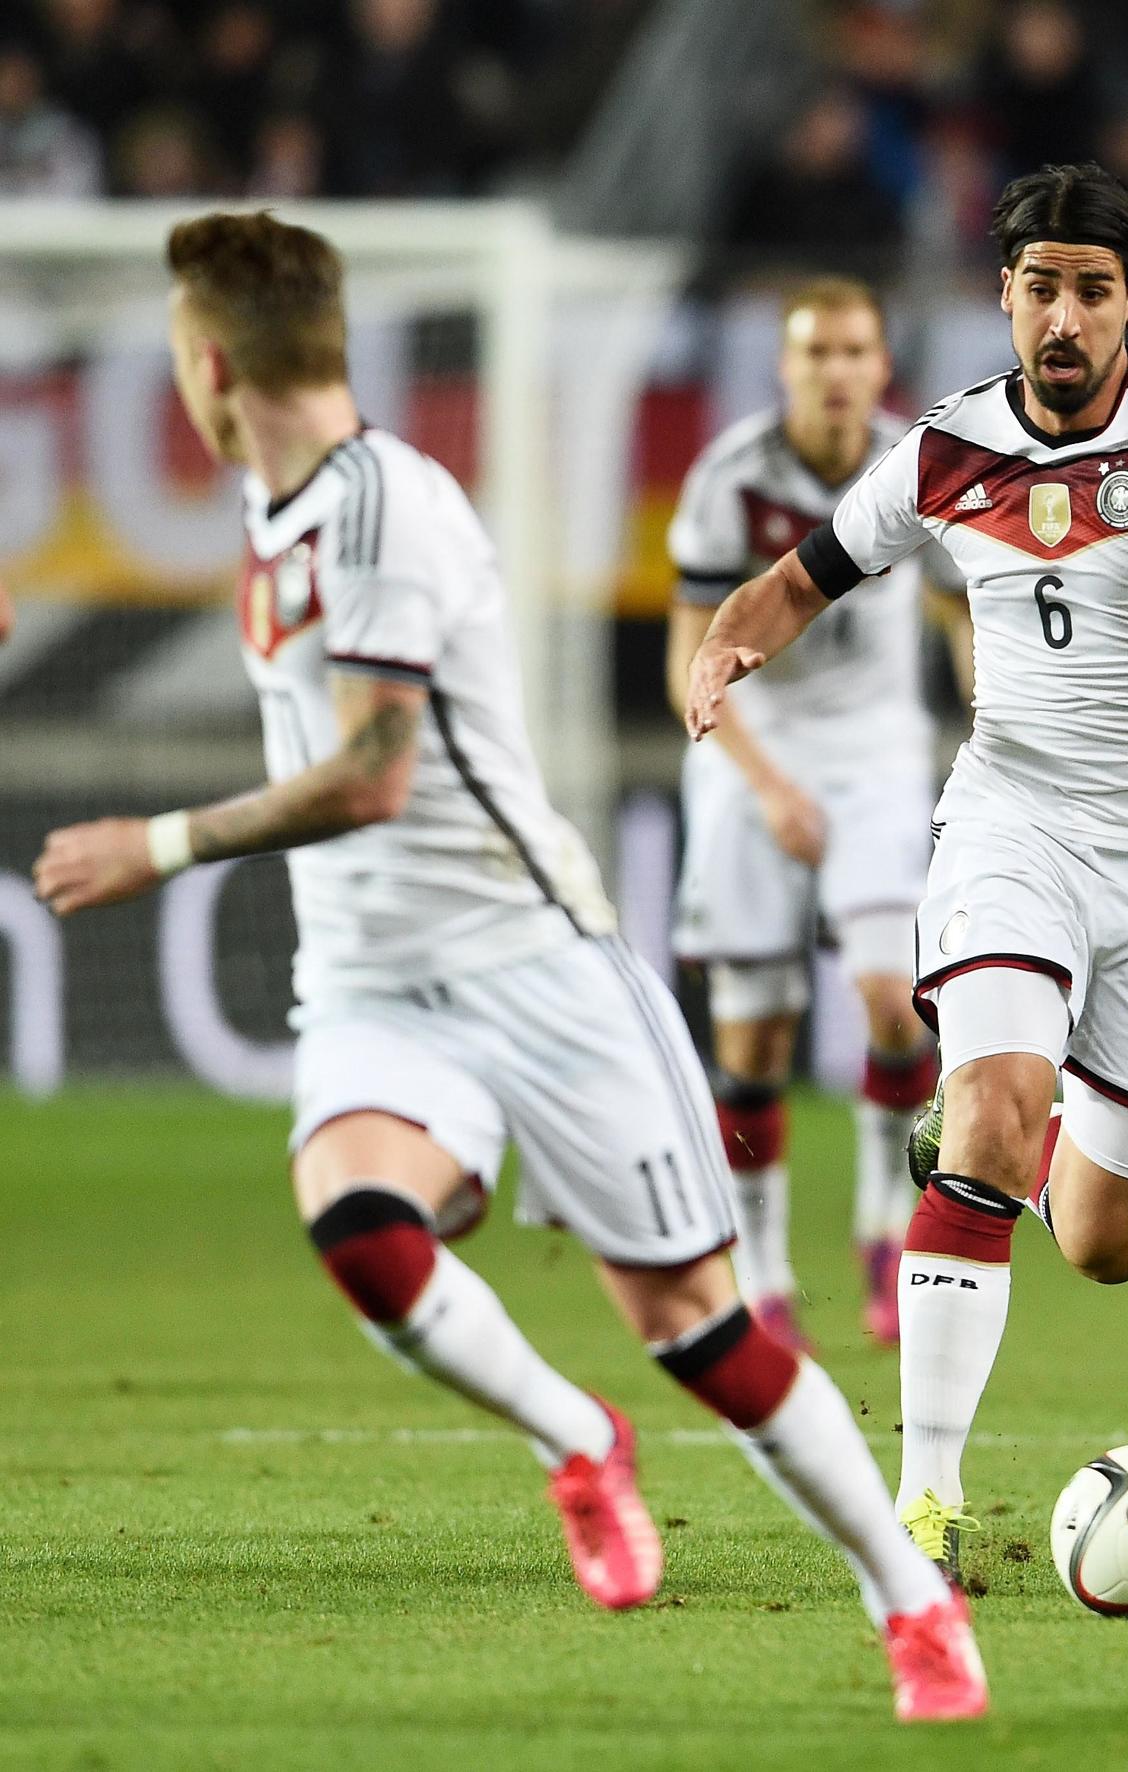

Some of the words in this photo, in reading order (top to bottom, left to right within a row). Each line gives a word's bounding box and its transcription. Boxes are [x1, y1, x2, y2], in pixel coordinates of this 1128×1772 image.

[955, 499, 993, 511] adidas
[1034, 574, 1073, 650] 6
[635, 1151, 695, 1238] 11
[910, 1273, 979, 1290] DFB
